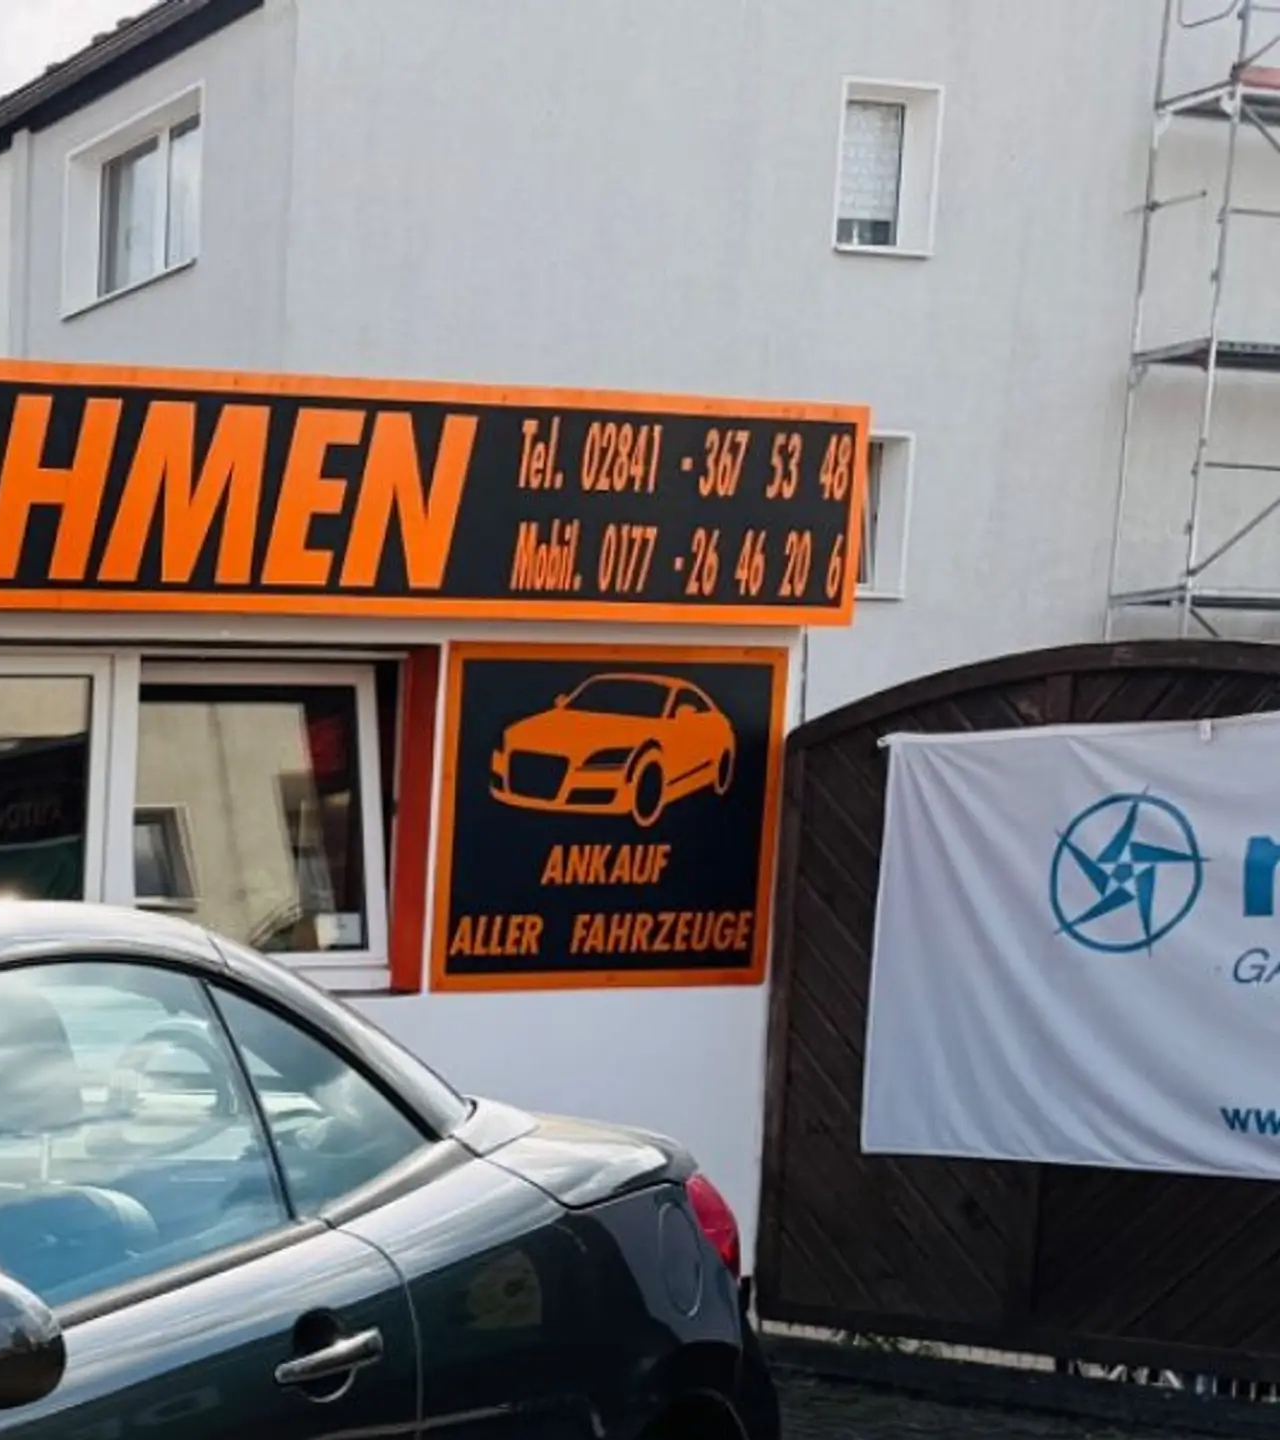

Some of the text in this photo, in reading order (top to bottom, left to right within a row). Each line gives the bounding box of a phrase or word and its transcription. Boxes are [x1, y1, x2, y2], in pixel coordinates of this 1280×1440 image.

[518, 415, 563, 490] Tel.
[581, 420, 663, 494] 02841
[766, 432, 802, 499] 53
[820, 433, 852, 501] 48
[509, 518, 582, 591] Mobil.
[597, 522, 658, 594] 0177
[734, 530, 767, 597] 46
[778, 530, 811, 597] 20
[825, 533, 844, 599] 6
[540, 843, 672, 887] ANKAUF
[450, 910, 753, 957] ALLER FAHRZEUGE
